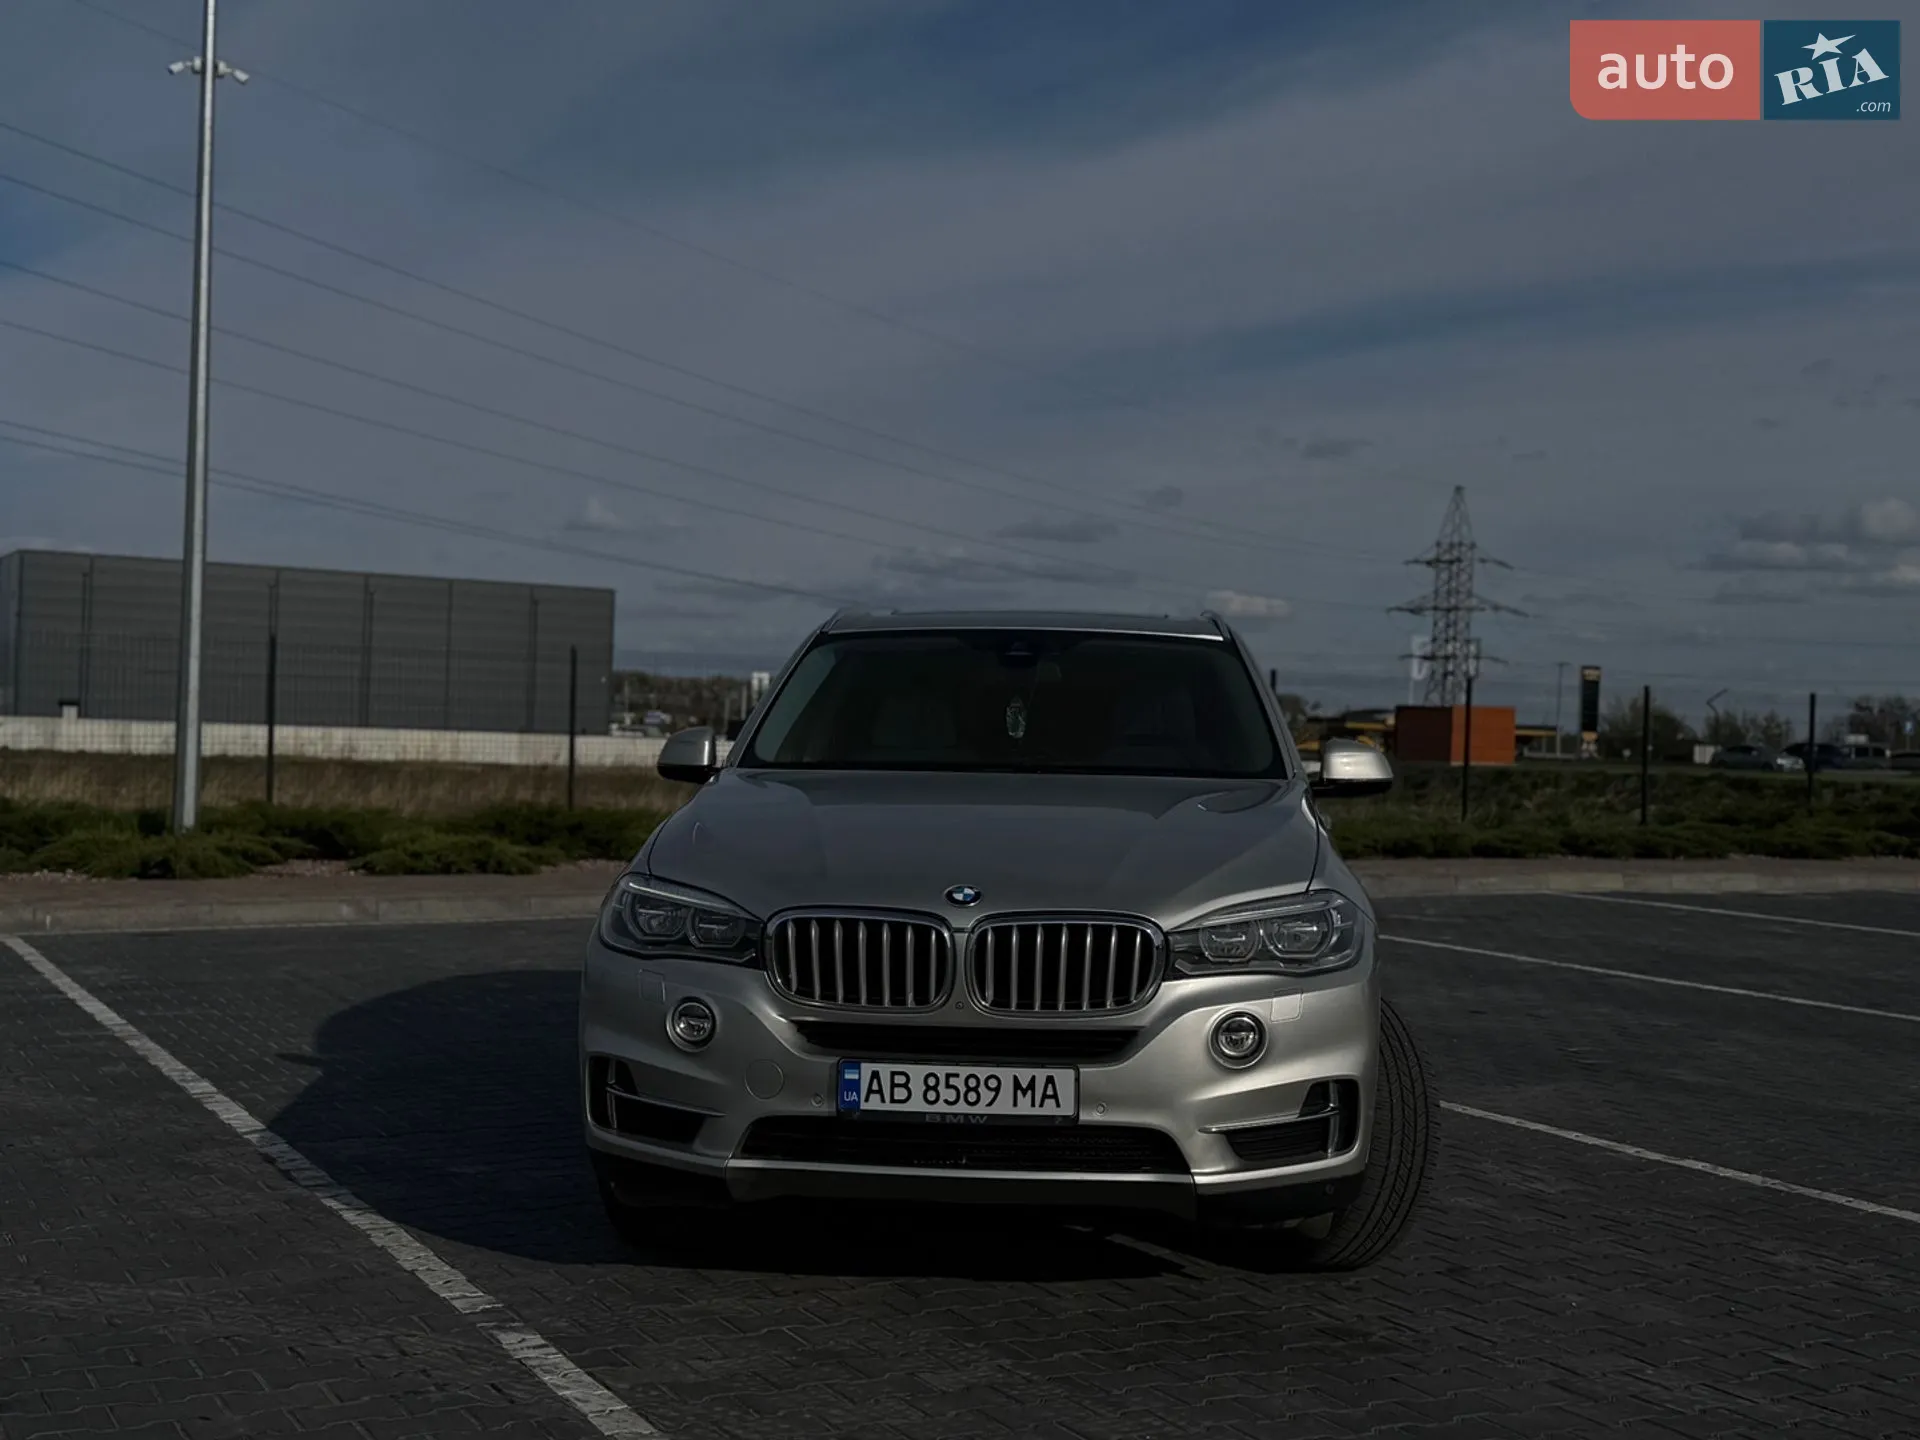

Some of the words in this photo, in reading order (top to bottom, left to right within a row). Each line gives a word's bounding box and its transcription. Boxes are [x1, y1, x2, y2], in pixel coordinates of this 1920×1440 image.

[864, 1070, 912, 1104] AB
[922, 1072, 1002, 1107] 8589
[1012, 1074, 1061, 1108] MA
[843, 1091, 859, 1102] UA
[925, 1113, 988, 1124] BMW
